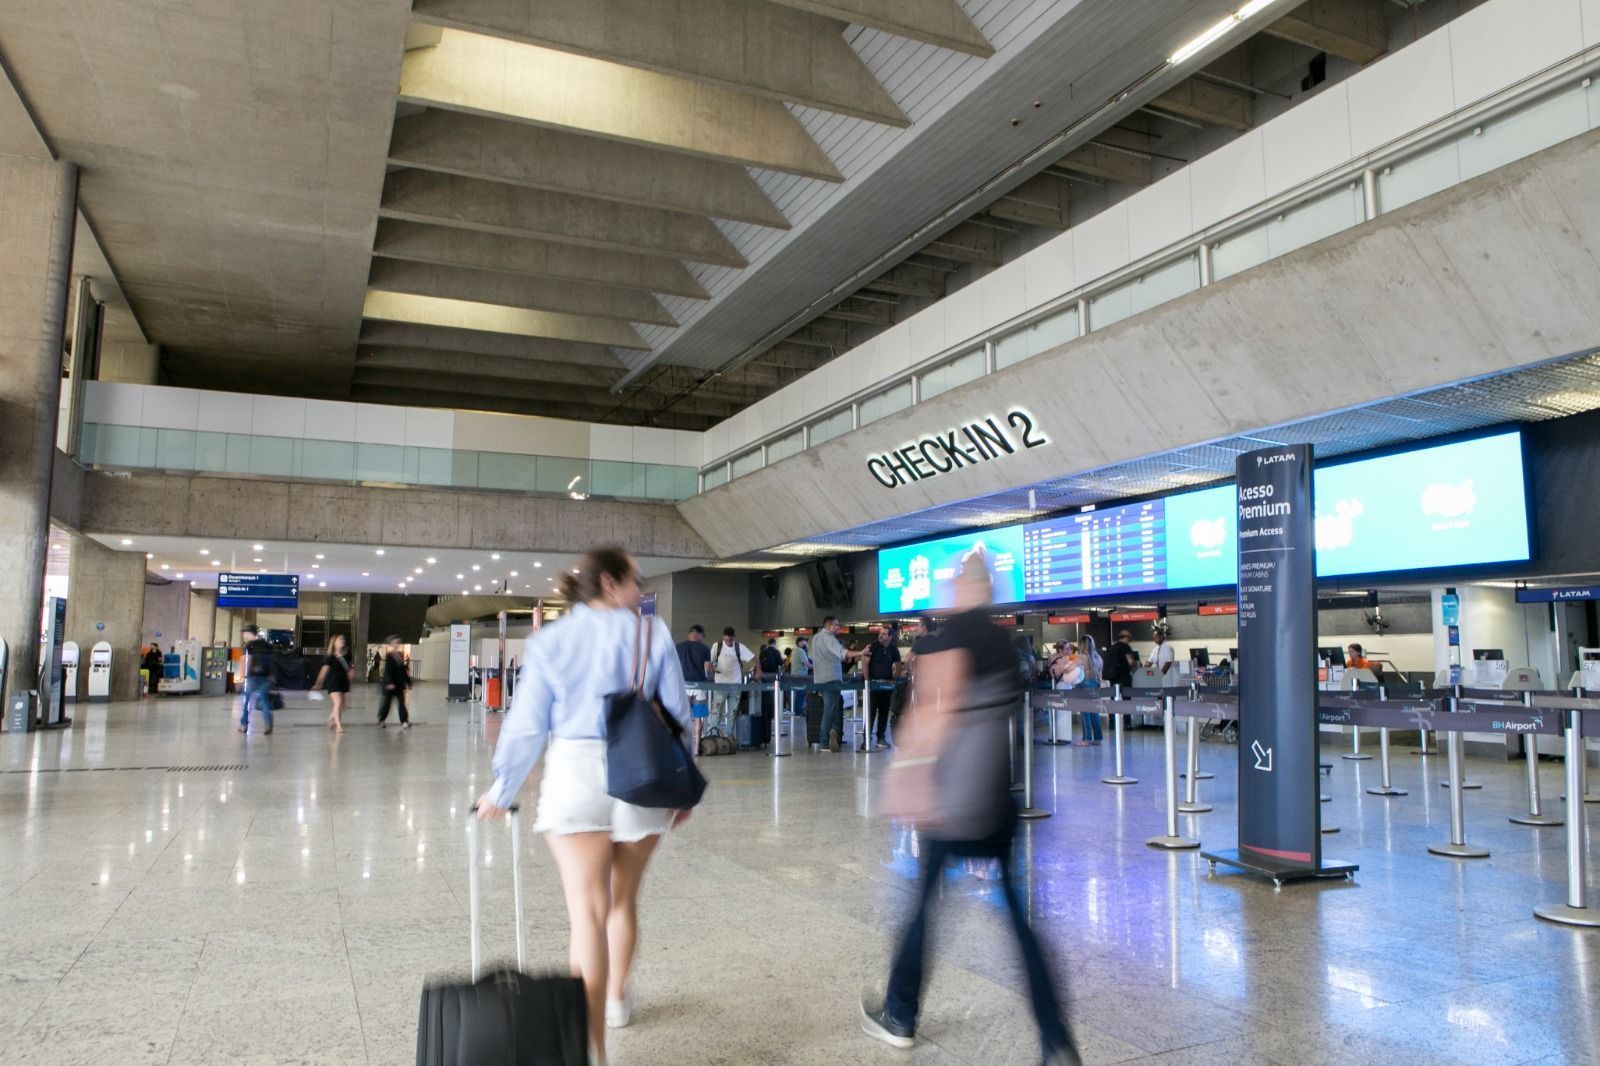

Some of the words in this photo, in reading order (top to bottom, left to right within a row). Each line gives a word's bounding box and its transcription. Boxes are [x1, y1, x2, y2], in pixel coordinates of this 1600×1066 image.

[867, 418, 1015, 489] CHECK-IN
[1007, 411, 1046, 449] 2
[1263, 453, 1296, 465] LATAM
[1259, 527, 1284, 537] Access
[1559, 590, 1591, 598] LATAM
